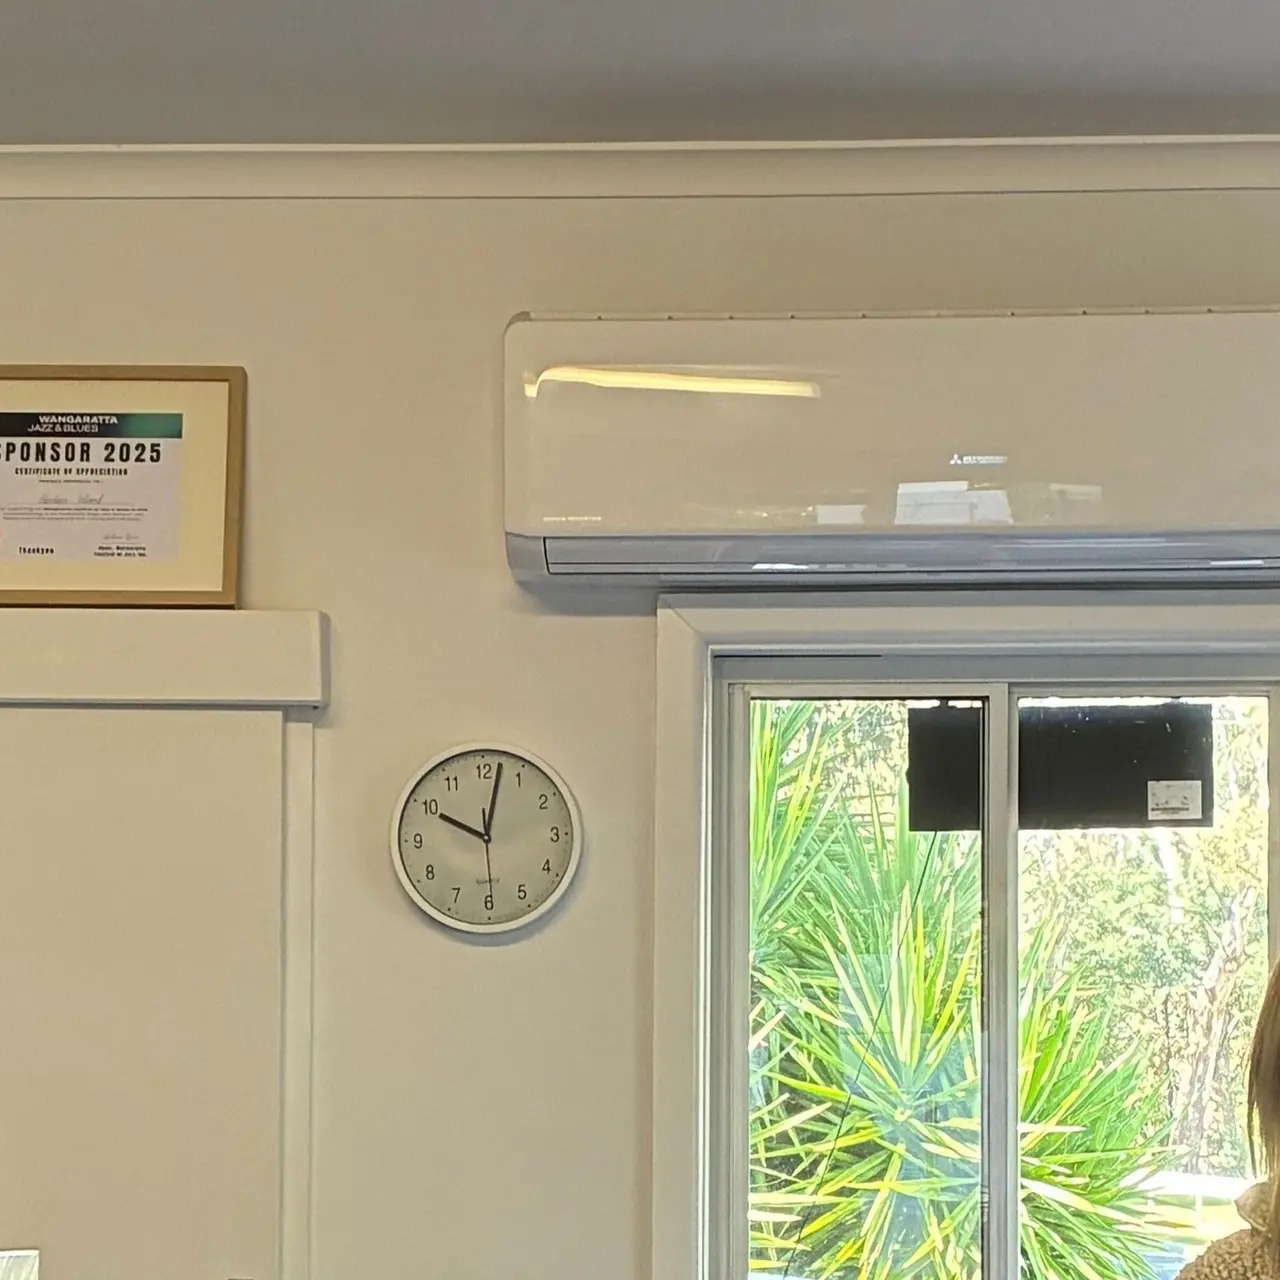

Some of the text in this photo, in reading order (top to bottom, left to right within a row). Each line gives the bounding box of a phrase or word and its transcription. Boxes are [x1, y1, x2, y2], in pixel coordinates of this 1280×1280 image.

[38, 415, 119, 425] WANGARATTA
[27, 424, 99, 433] JAZZ & BLUES
[104, 443, 162, 463] 2025
[476, 763, 493, 780] 12
[444, 776, 459, 791] 11
[515, 772, 521, 788] 1
[422, 798, 439, 816] 10
[538, 794, 549, 810] 2
[413, 833, 423, 849] 9
[550, 826, 560, 843] 3
[425, 864, 435, 880] 8
[541, 858, 552, 874] 4
[452, 887, 461, 903] 7
[517, 884, 527, 900] 5
[484, 894, 495, 910] 6
